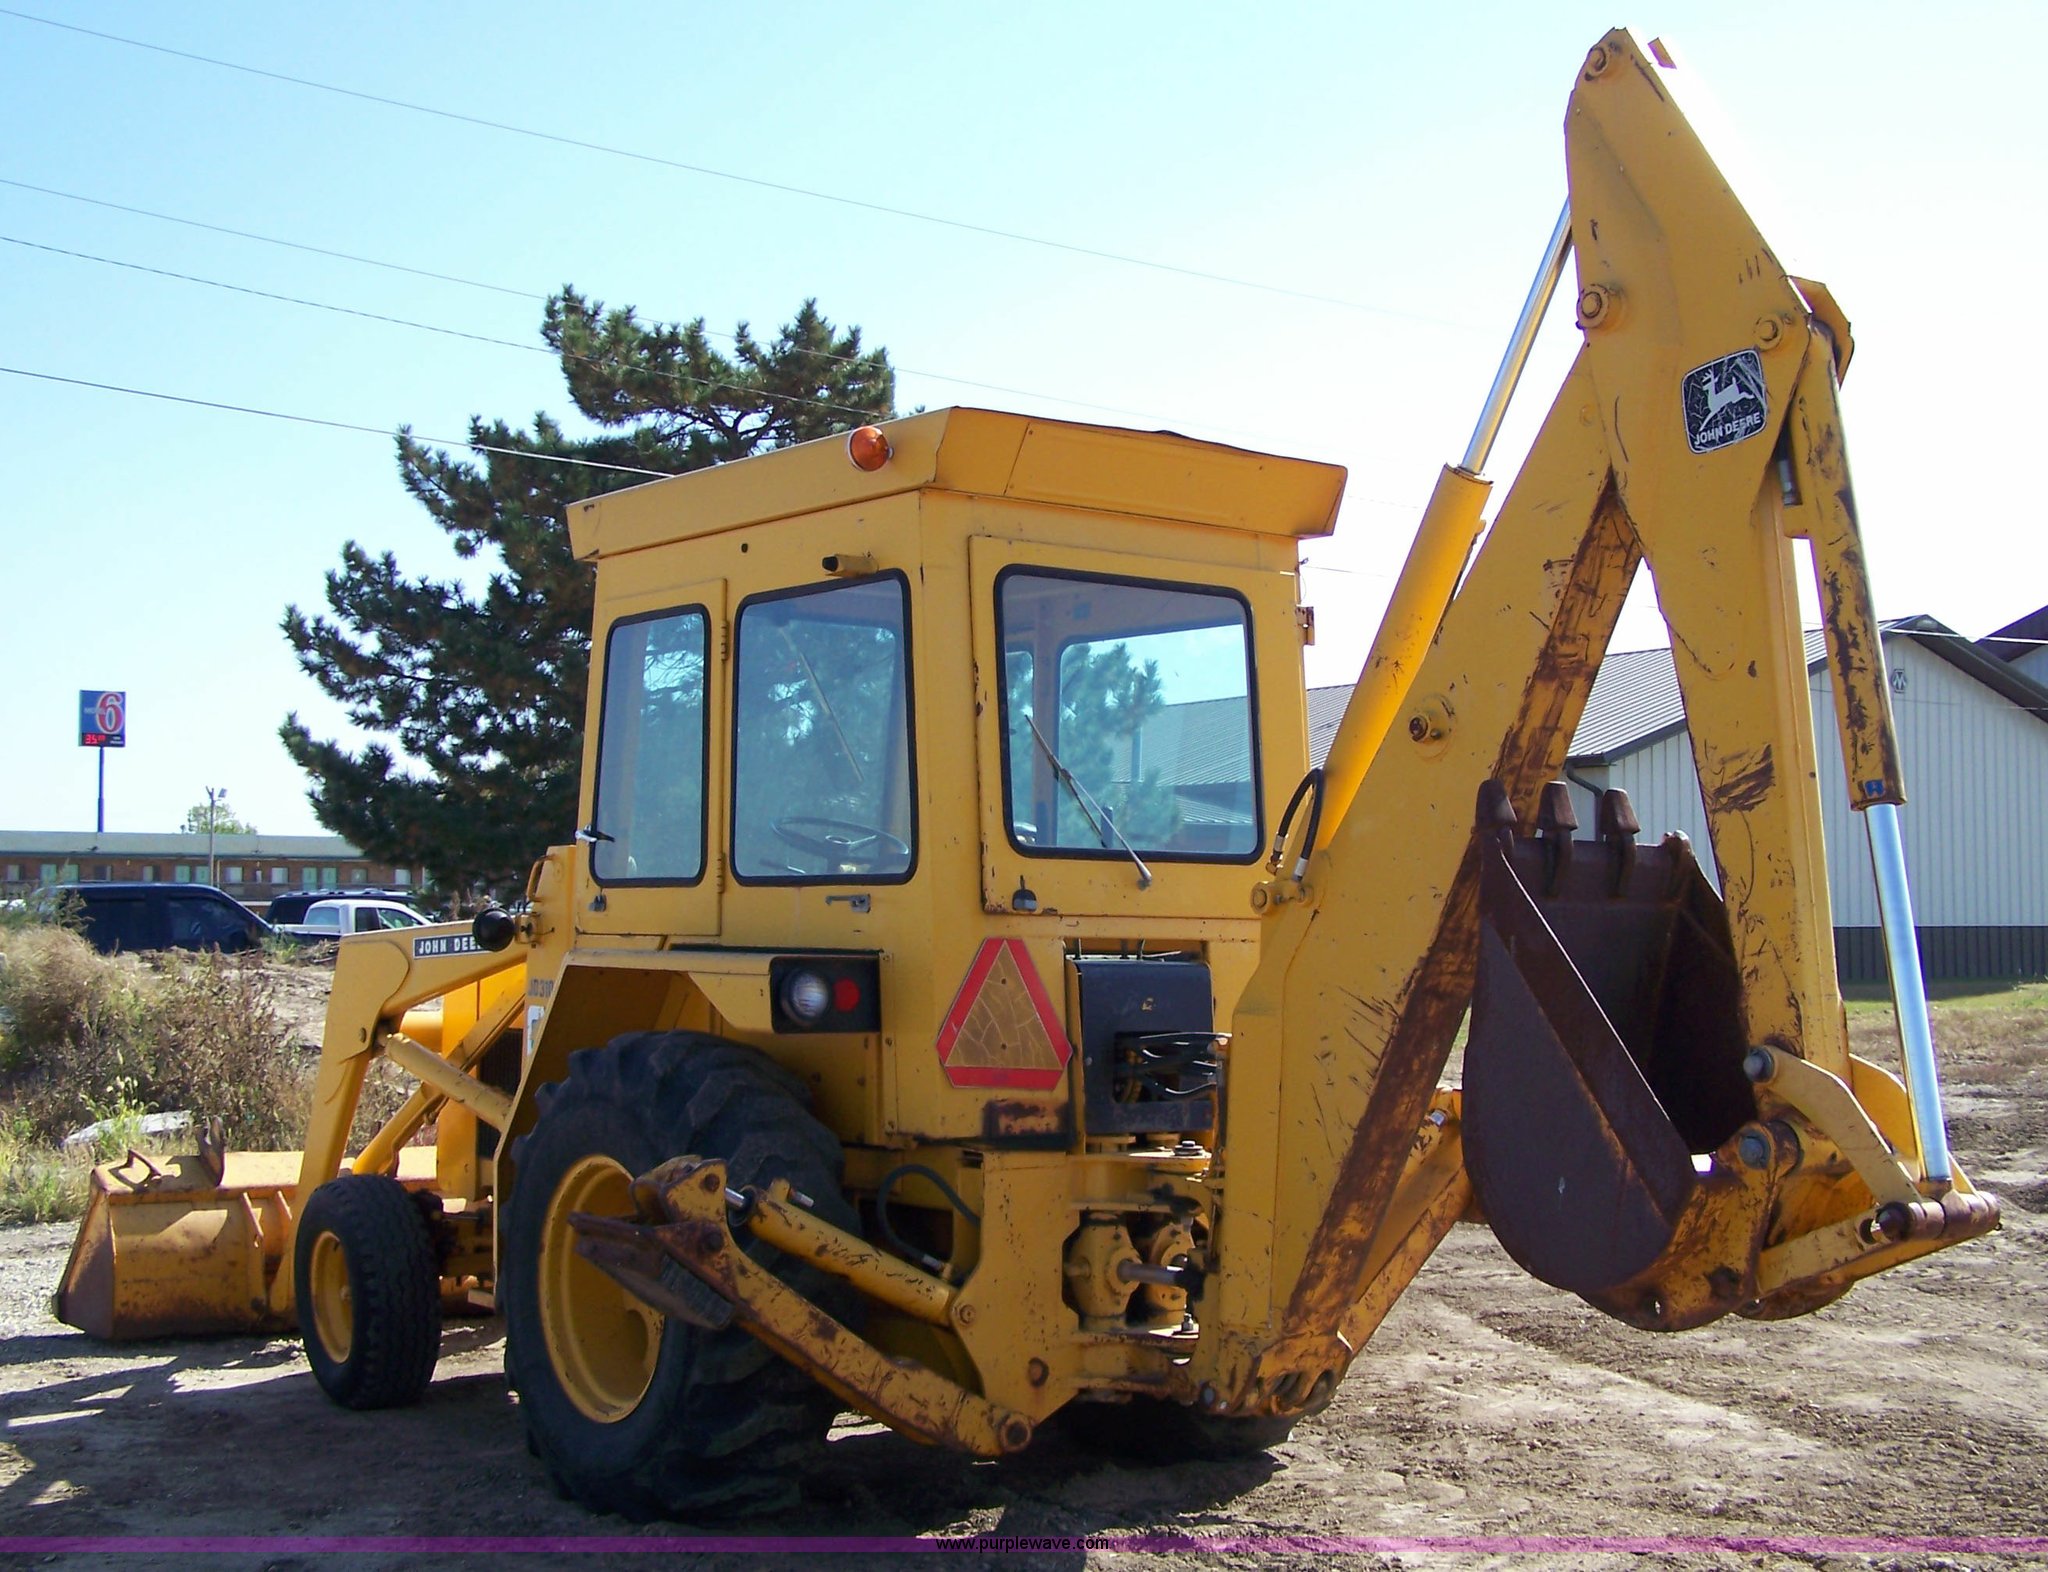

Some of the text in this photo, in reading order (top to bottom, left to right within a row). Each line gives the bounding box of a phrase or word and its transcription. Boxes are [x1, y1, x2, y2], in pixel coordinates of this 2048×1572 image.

[1693, 412, 1761, 445] JOHN DEERE
[96, 692, 123, 734] 6
[418, 936, 481, 954] JOHN DEE
